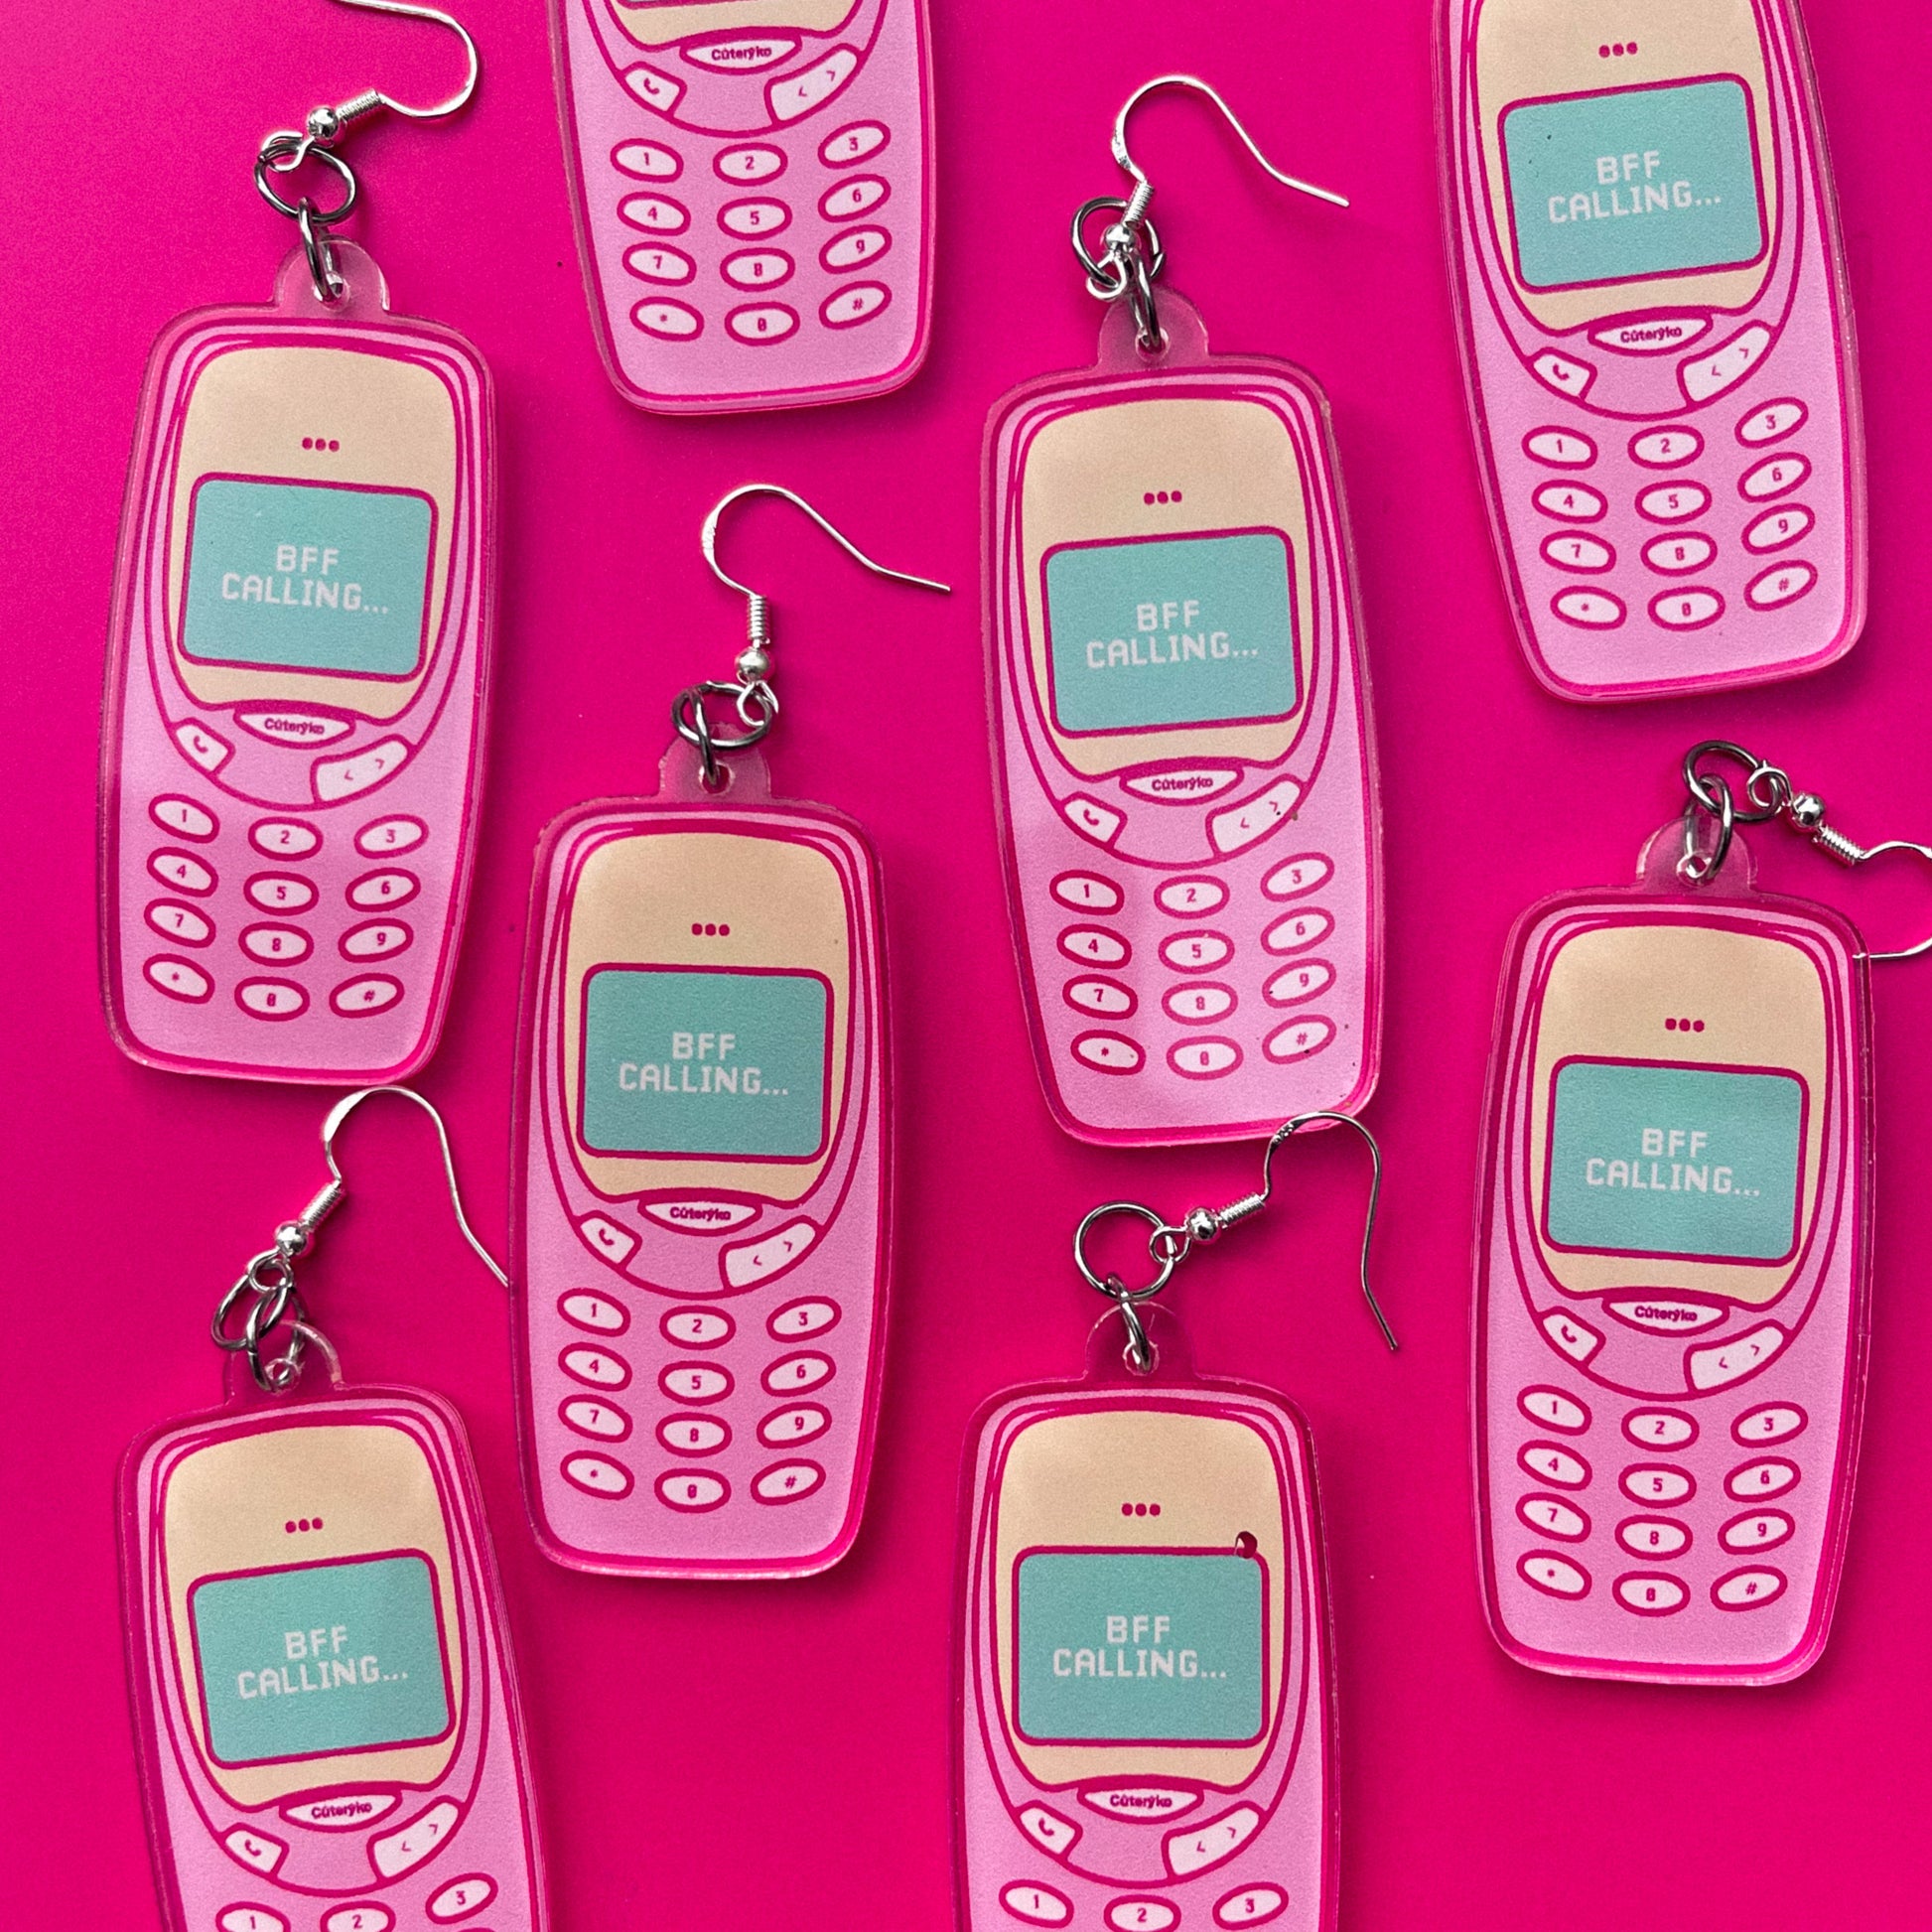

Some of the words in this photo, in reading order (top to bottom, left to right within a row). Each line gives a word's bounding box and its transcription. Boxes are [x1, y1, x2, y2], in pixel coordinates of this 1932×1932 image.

[745, 155, 756, 171] 2
[848, 135, 860, 152] 3
[1596, 150, 1660, 185] BFF
[646, 206, 658, 221] 4
[749, 209, 760, 226] 5
[851, 187, 863, 204] 6
[1548, 180, 1722, 223] CALLING...
[652, 254, 663, 270] 7
[753, 261, 764, 278] 8
[854, 238, 867, 255] 9
[756, 316, 768, 334] 0
[1660, 437, 1672, 455] 2
[1764, 414, 1777, 431] 3
[1563, 493, 1575, 509] 4
[1667, 492, 1680, 510] 5
[1771, 467, 1783, 483] 6
[1571, 542, 1582, 559] 7
[1674, 545, 1686, 562] 8
[1777, 517, 1790, 534] 9
[275, 544, 339, 575] BFF
[221, 572, 390, 614] CALLING...
[1681, 602, 1693, 618] 0
[1137, 600, 1199, 631] BFF
[1086, 631, 1259, 669] CALLING...
[279, 829, 291, 846] 2
[385, 828, 396, 844] 3
[175, 863, 188, 880] 4
[275, 885, 288, 901] 5
[379, 880, 392, 897] 6
[1185, 887, 1196, 903] 2
[1291, 869, 1303, 885] 3
[174, 912, 185, 929] 7
[270, 936, 283, 953] 8
[374, 930, 388, 948] 9
[1087, 937, 1100, 954] 4
[1190, 943, 1202, 960] 5
[1295, 920, 1307, 936] 6
[265, 991, 278, 1009] 0
[1092, 987, 1105, 1004] 7
[1194, 995, 1206, 1012] 8
[1299, 972, 1311, 988] 9
[673, 1033, 735, 1059] BFF
[1198, 1050, 1210, 1067] 0
[620, 1063, 788, 1095] CALLING...
[1642, 1128, 1707, 1158] BFF
[1586, 1158, 1760, 1196] CALLING...
[691, 1316, 704, 1334] 2
[797, 1311, 809, 1327] 3
[588, 1358, 601, 1375] 4
[690, 1374, 703, 1391] 5
[795, 1363, 807, 1380] 6
[589, 1408, 601, 1425] 7
[688, 1427, 701, 1445] 8
[793, 1415, 805, 1432] 9
[1654, 1420, 1667, 1436] 2
[1762, 1416, 1775, 1433] 3
[686, 1482, 699, 1501] 0
[1547, 1456, 1560, 1472] 4
[1652, 1476, 1664, 1494] 5
[1759, 1468, 1771, 1486] 6
[1547, 1506, 1559, 1523] 7
[1648, 1529, 1661, 1547] 8
[1756, 1521, 1768, 1539] 9
[1645, 1587, 1657, 1603] 0
[285, 1625, 346, 1660] BFF
[1107, 1615, 1171, 1643] BFF
[237, 1655, 408, 1700] CALLING...
[1053, 1648, 1227, 1678] CALLING...
[351, 1913, 363, 1930] 2
[455, 1889, 468, 1907] 3
[1136, 1906, 1148, 1924] 2
[1244, 1896, 1256, 1915] 3
